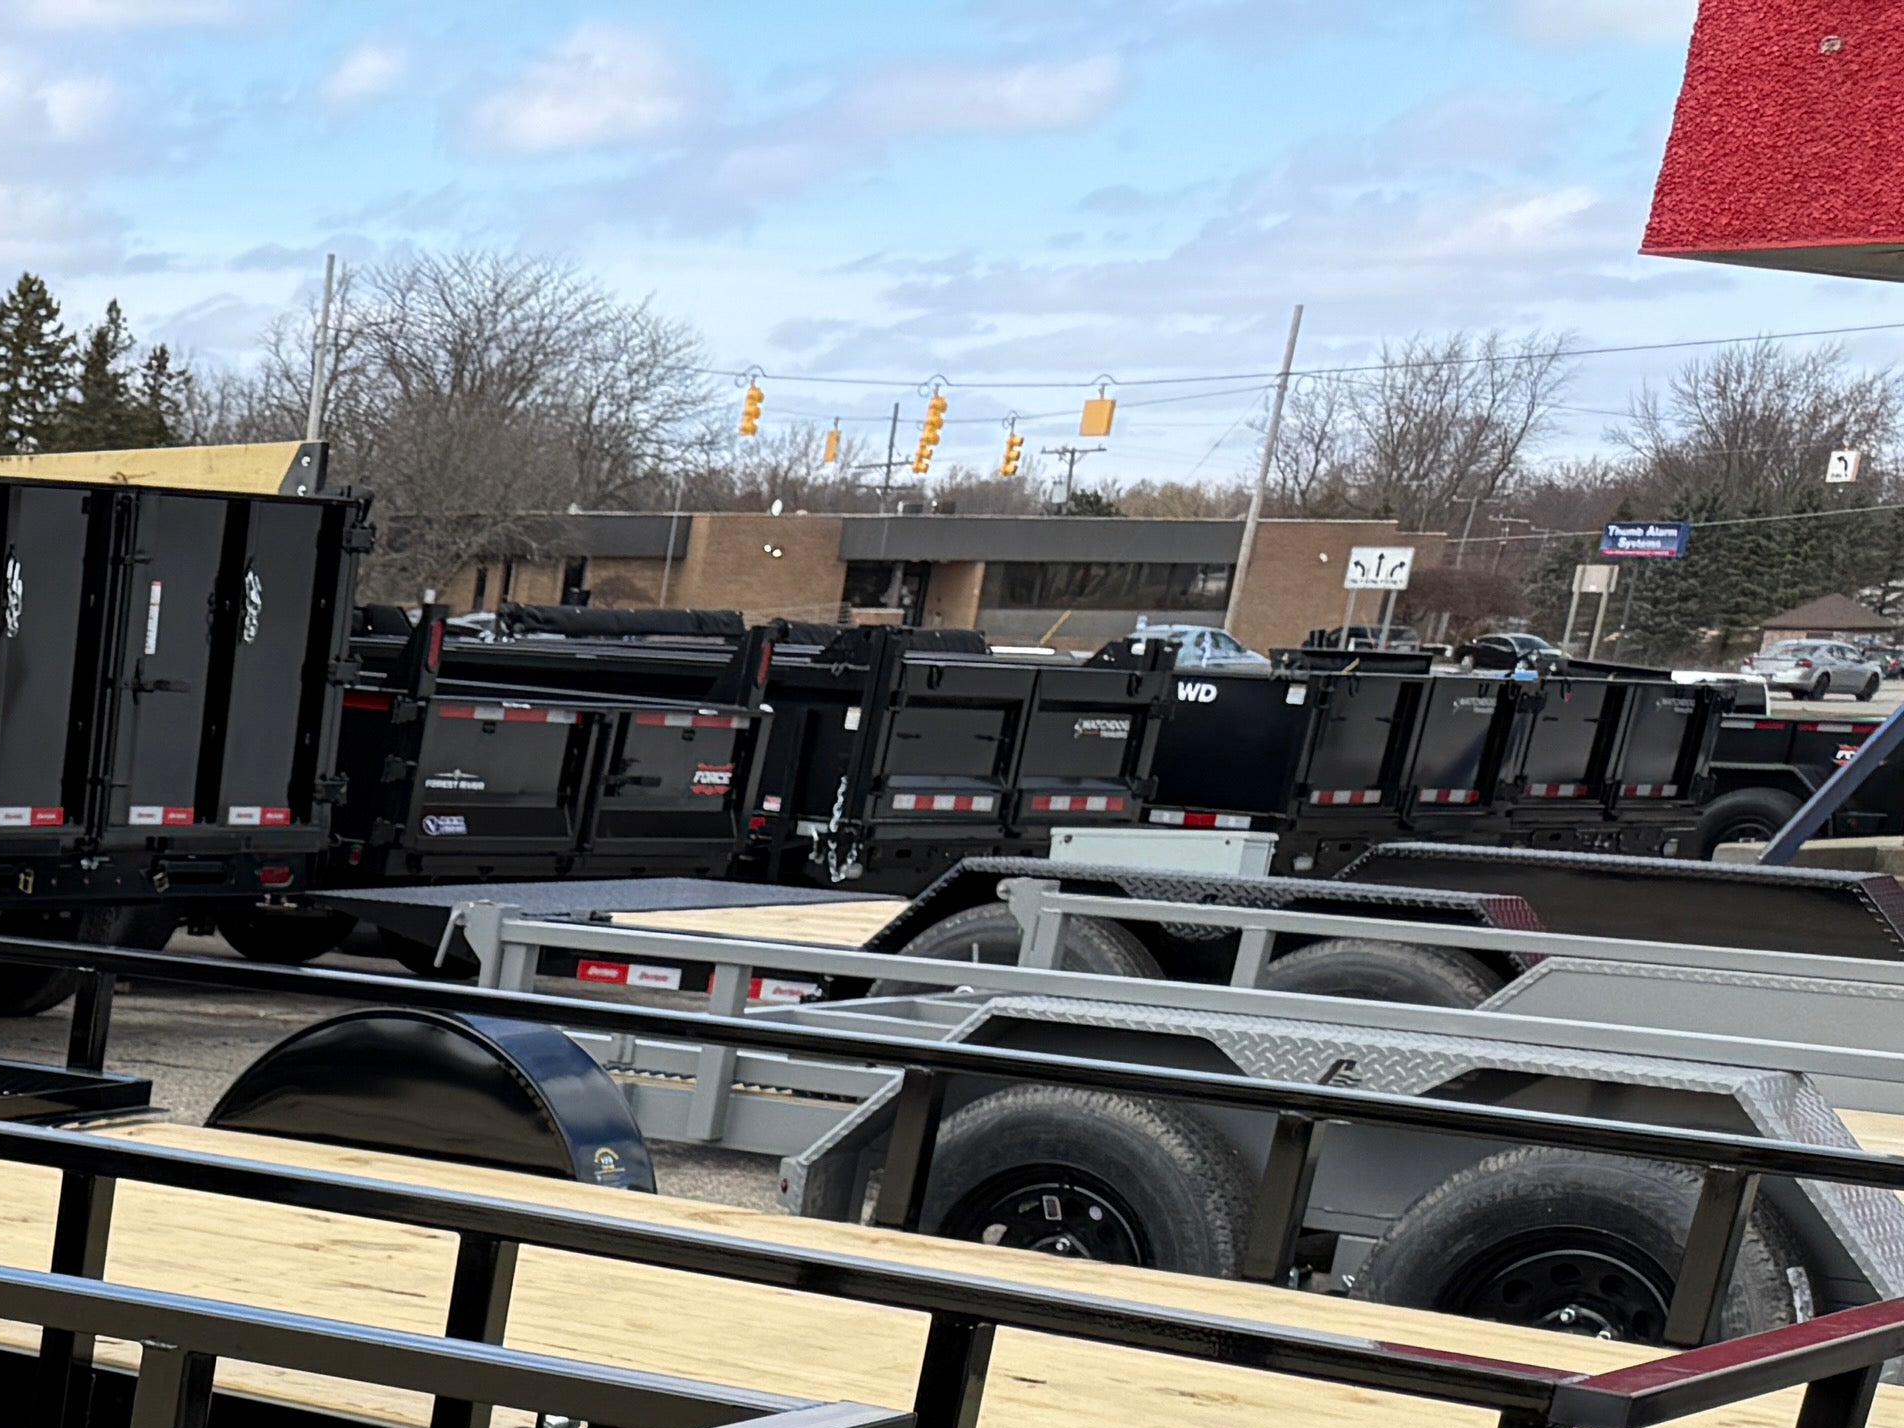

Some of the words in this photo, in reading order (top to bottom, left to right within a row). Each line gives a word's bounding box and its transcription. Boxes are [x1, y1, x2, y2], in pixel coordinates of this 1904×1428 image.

[1608, 525, 1644, 536] Thumb
[1646, 525, 1678, 536] Alarm
[1177, 681, 1218, 703] WD
